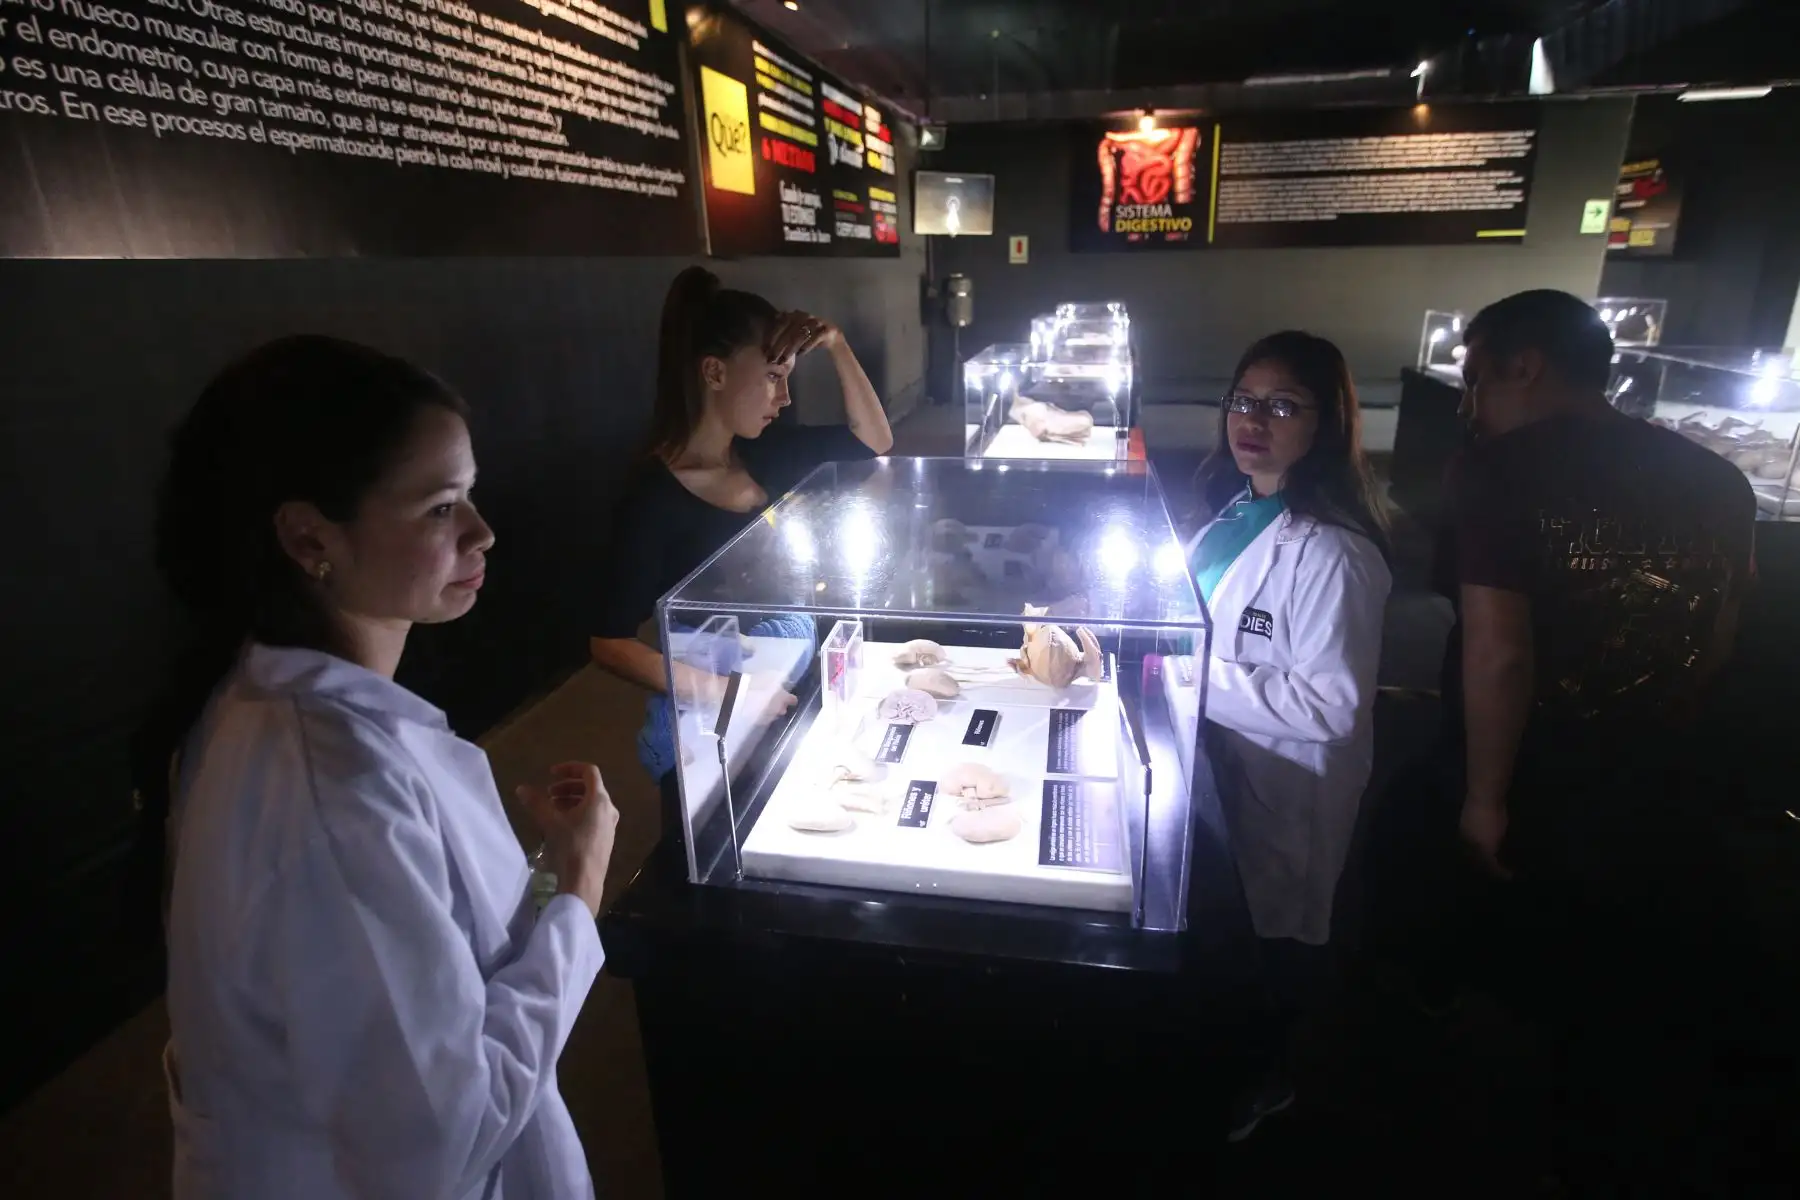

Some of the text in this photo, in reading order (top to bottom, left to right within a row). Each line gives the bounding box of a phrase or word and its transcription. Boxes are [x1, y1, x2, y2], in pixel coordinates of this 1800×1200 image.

[188, 0, 246, 26] Otras
[247, 12, 341, 51] estructuras
[341, 33, 425, 73] importantes
[425, 61, 446, 79] son
[446, 61, 465, 84] los
[308, 1, 337, 23] por
[337, 5, 362, 31] los
[363, 19, 413, 47] ovarios
[413, 29, 431, 52] de
[383, 0, 404, 21] los
[404, 9, 430, 29] que
[429, 13, 461, 40] tiene
[16, 17, 43, 43] el
[48, 27, 199, 77] endometrio,
[201, 60, 249, 87] cuya
[252, 70, 296, 96] capa
[297, 76, 333, 100] más
[333, 86, 388, 111] externa
[389, 99, 407, 115] se
[407, 102, 454, 124] expulsa
[455, 107, 497, 133] durante
[60, 0, 139, 30] hueco
[143, 16, 238, 52] muscular
[242, 39, 278, 61] con
[279, 42, 331, 73] forma
[332, 55, 354, 79] de
[355, 66, 390, 87] pera
[390, 69, 412, 92] del
[412, 75, 459, 103] tamaño
[12, 56, 47, 78] es
[50, 62, 104, 87] una
[106, 68, 175, 99] célula
[177, 78, 208, 105] de
[210, 91, 258, 113] gran
[260, 94, 331, 128] tamaño,
[332, 112, 362, 132] que
[364, 113, 378, 133] al
[378, 120, 400, 136] ser
[402, 121, 466, 147] atravesada
[466, 135, 486, 153] por
[60, 92, 100, 120] En
[103, 105, 148, 127] ese
[150, 112, 247, 140] procesos
[249, 121, 268, 143] el
[269, 129, 394, 159] espermatozoide
[394, 142, 436, 165] pierde
[436, 146, 449, 166] la
[449, 150, 473, 169] cola
[1115, 204, 1173, 219] SISTEMA
[1115, 217, 1192, 233] DIGESTIVO
[900, 792, 918, 819] Riñones
[920, 793, 932, 812] uréter
